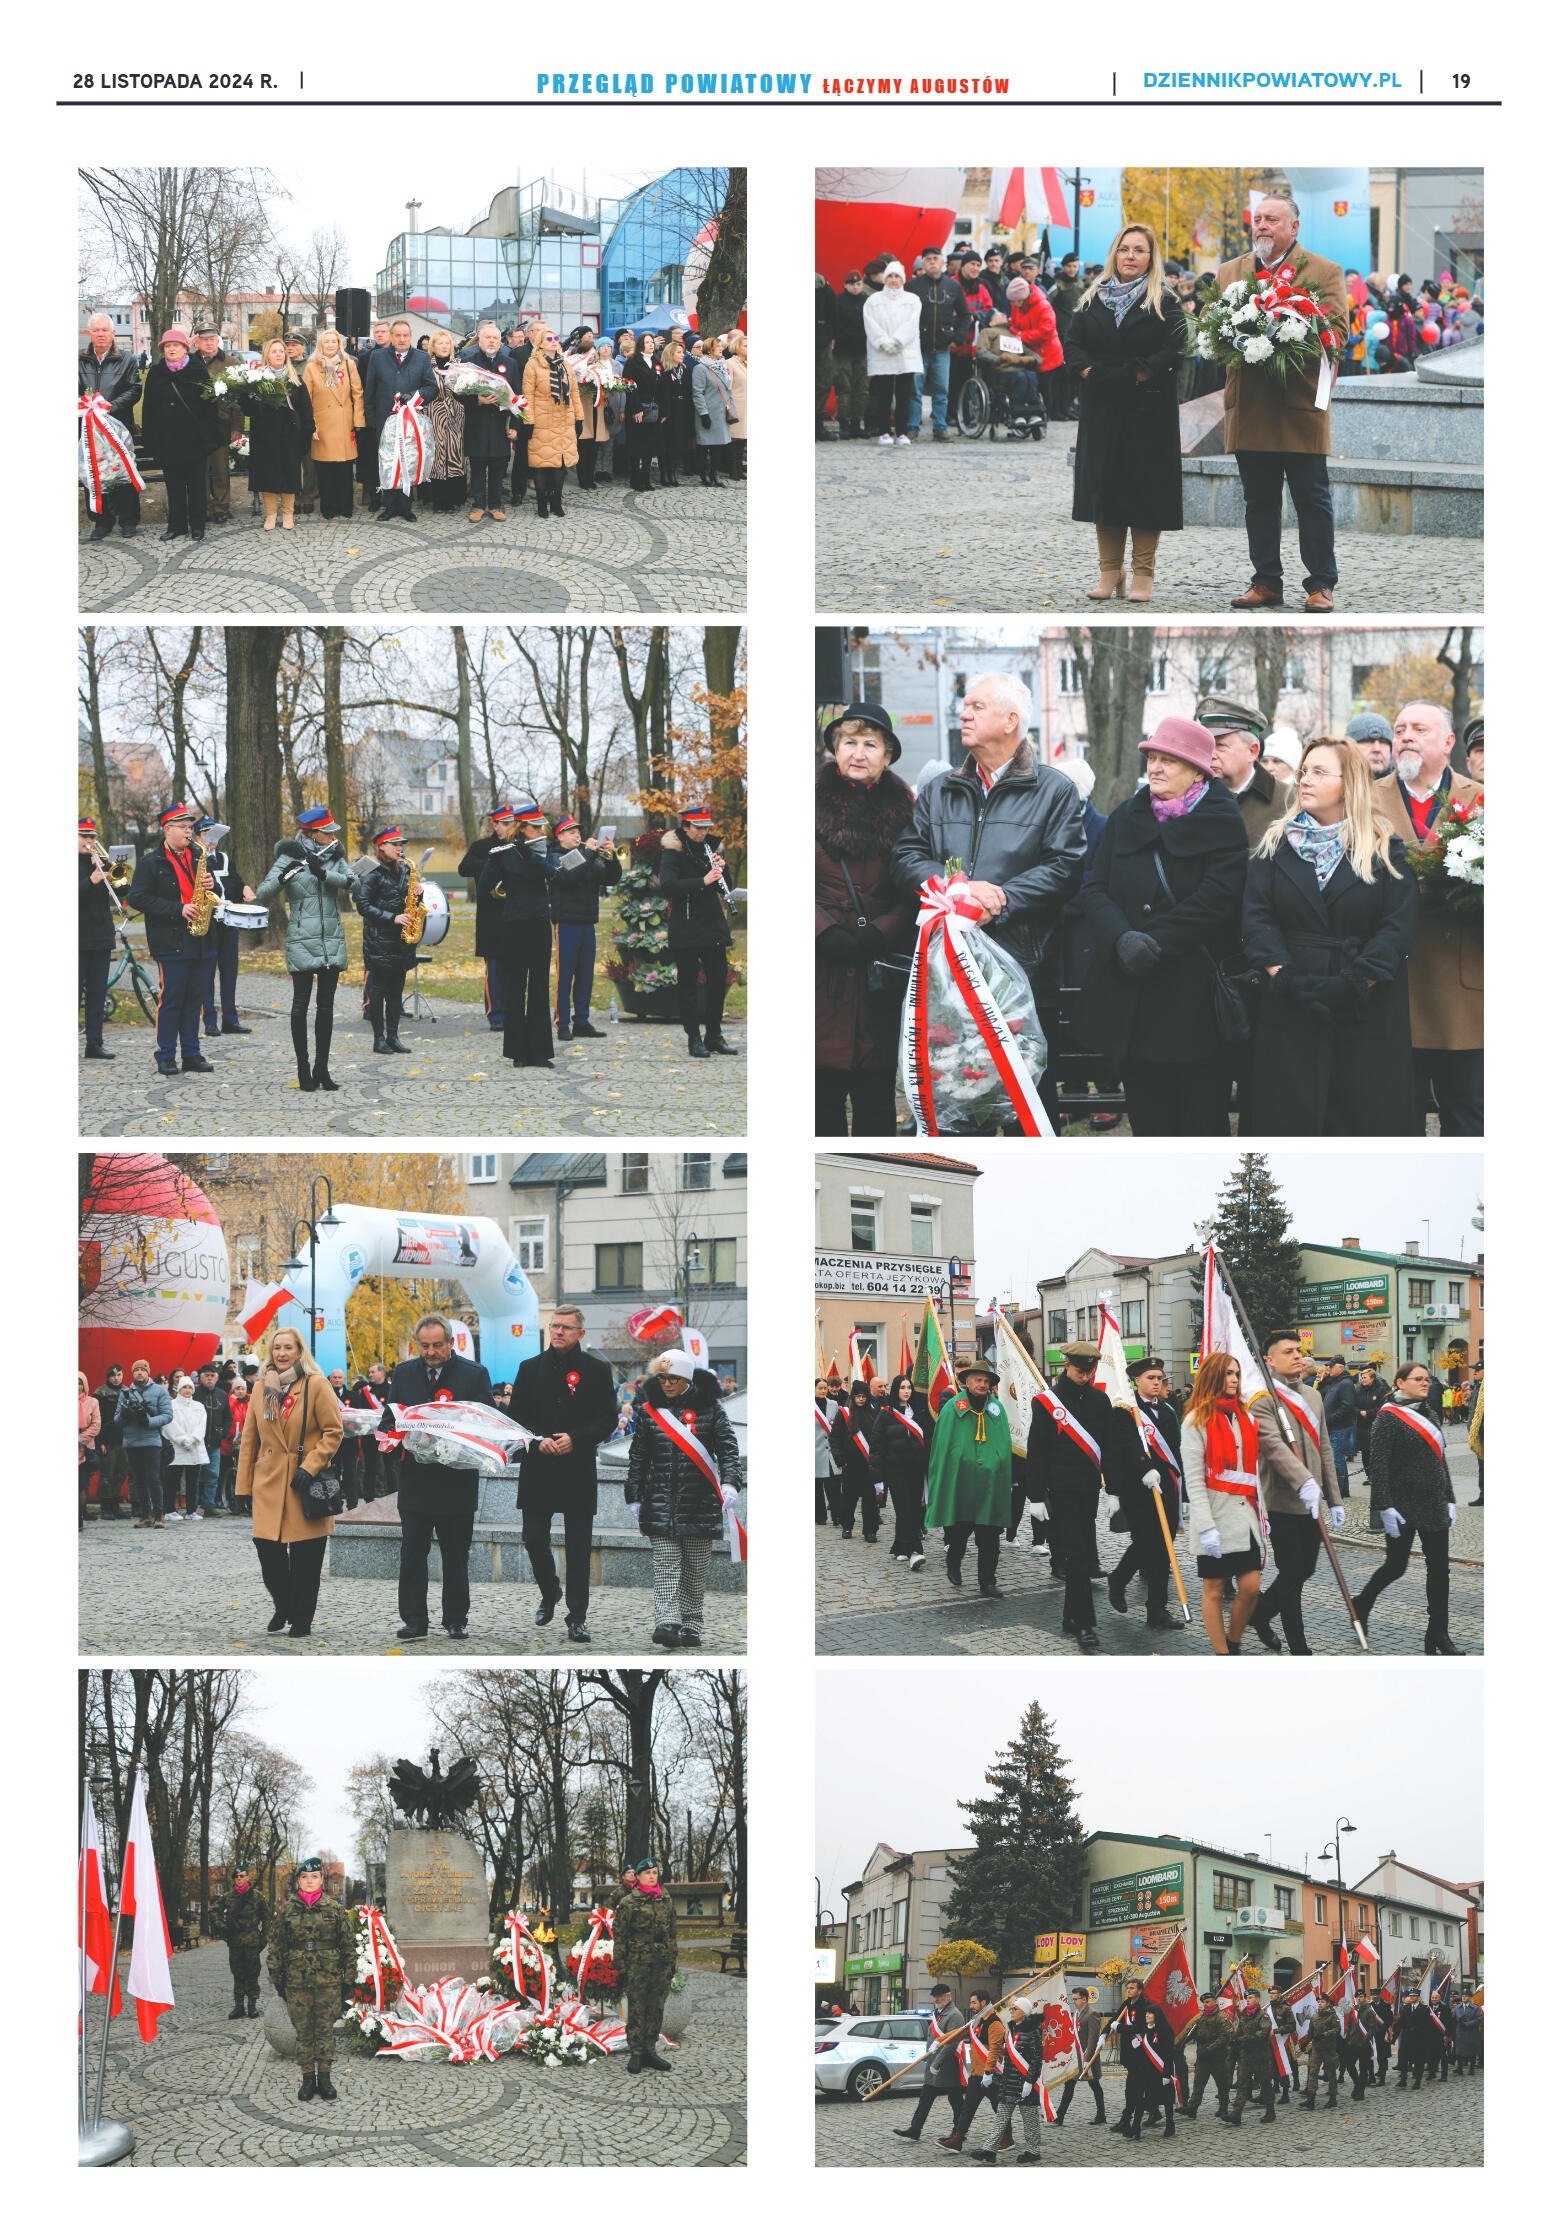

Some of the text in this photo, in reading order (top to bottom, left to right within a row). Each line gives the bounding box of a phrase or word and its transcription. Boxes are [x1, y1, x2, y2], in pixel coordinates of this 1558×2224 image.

[73, 73, 278, 89] 28 LISTOPADA 2024 R.
[537, 73, 812, 98] PRZEGLĄD POWIATOWY
[822, 75, 1010, 97] ŁĄCZYMY AUGUSTÓW
[1143, 72, 1403, 88] DZIENNIKPOWIATOWY.PL
[1452, 73, 1471, 89] 19
[876, 1261, 943, 1275] PRZYSIĘGŁE
[835, 1270, 884, 1281] OFERTA
[851, 1282, 865, 1291] tel.
[867, 1282, 889, 1292] 604
[892, 1284, 906, 1293] 14
[910, 1285, 924, 1294] 22
[1346, 1280, 1385, 1291] LOOMBARD
[1138, 1869, 1178, 1887] LOOMBARD
[1159, 1895, 1177, 1904] 150m
[1036, 1935, 1055, 1948] LODY
[1060, 1935, 1084, 1946] LODY
